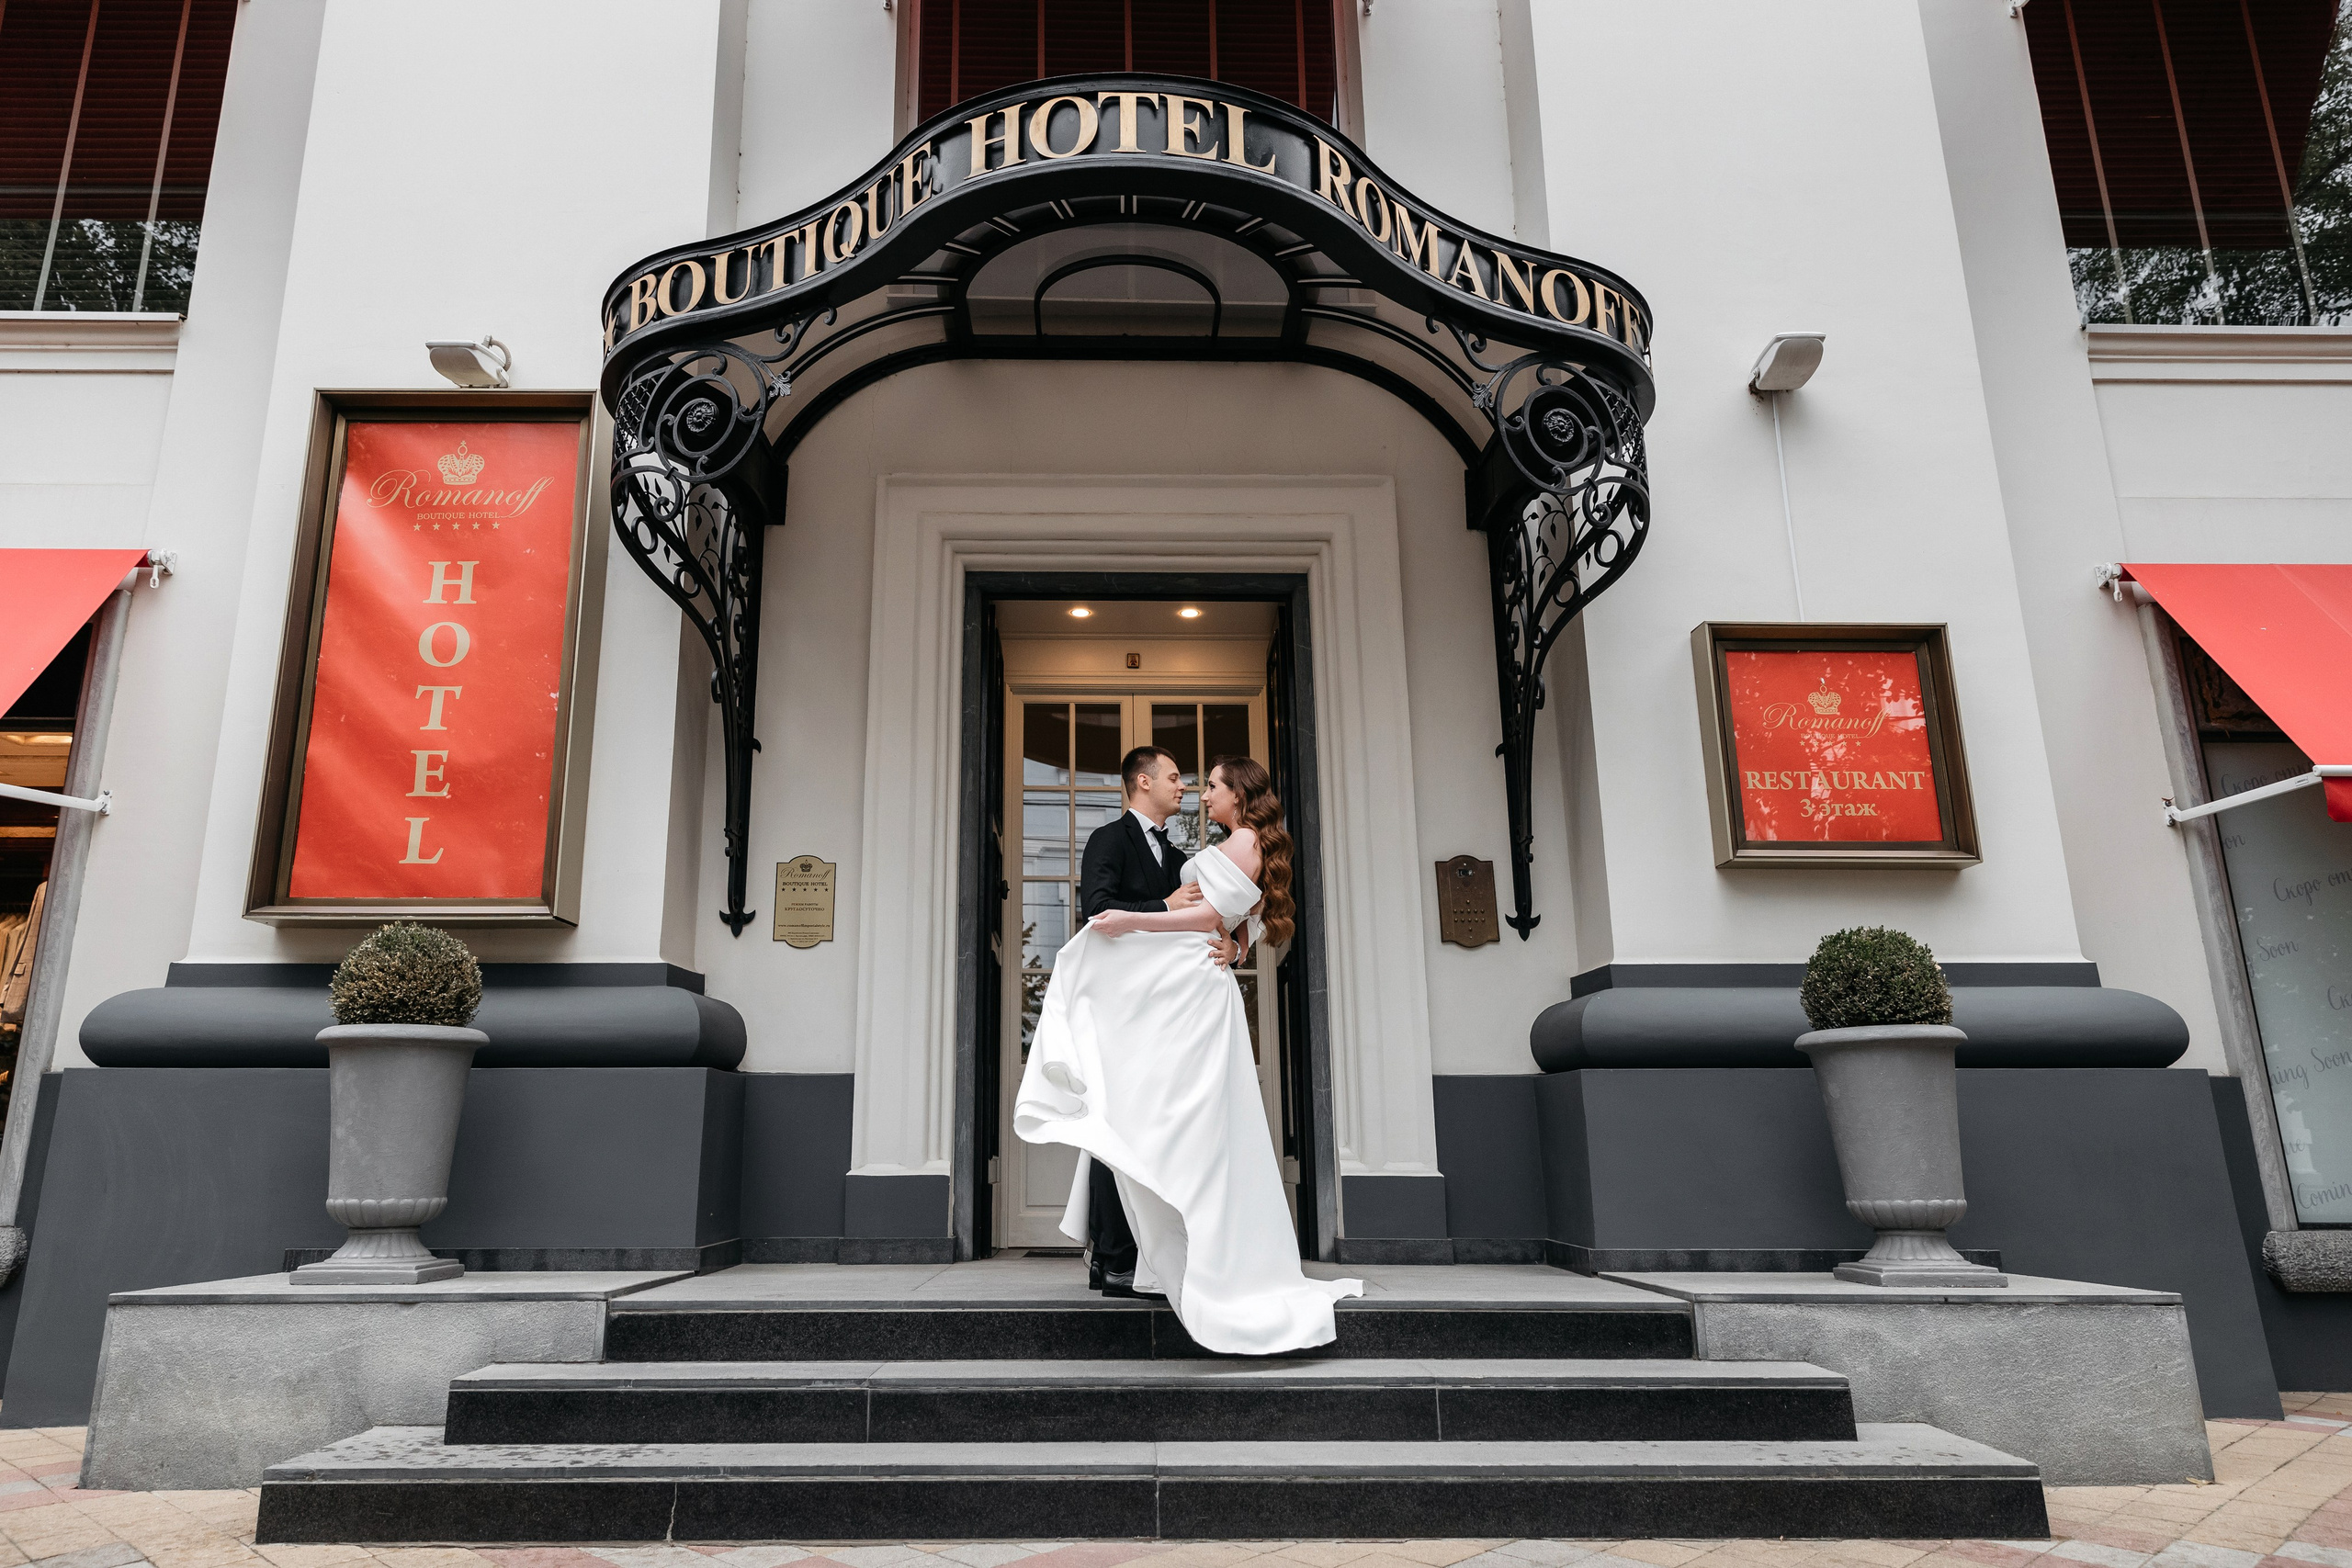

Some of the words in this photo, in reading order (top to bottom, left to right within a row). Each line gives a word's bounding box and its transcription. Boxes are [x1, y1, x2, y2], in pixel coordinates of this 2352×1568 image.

[627, 141, 935, 334] BOUTIQUE
[964, 92, 1276, 181] HOTEL
[1312, 135, 1642, 351] ROMANOFF
[367, 468, 555, 518] Romanoff
[416, 512, 466, 521] BOUTIQUE
[398, 560, 480, 865] HOTEL
[1762, 702, 1891, 739] Romanoff
[1744, 771, 1925, 790] RESTAURANT
[1800, 798, 1813, 818] 3
[1821, 802, 1878, 817] этаж
[780, 866, 831, 881] Romanoff
[2273, 877, 2323, 906] Скоро
[2256, 937, 2300, 961] Soon
[2311, 1046, 2352, 1073] Soon
